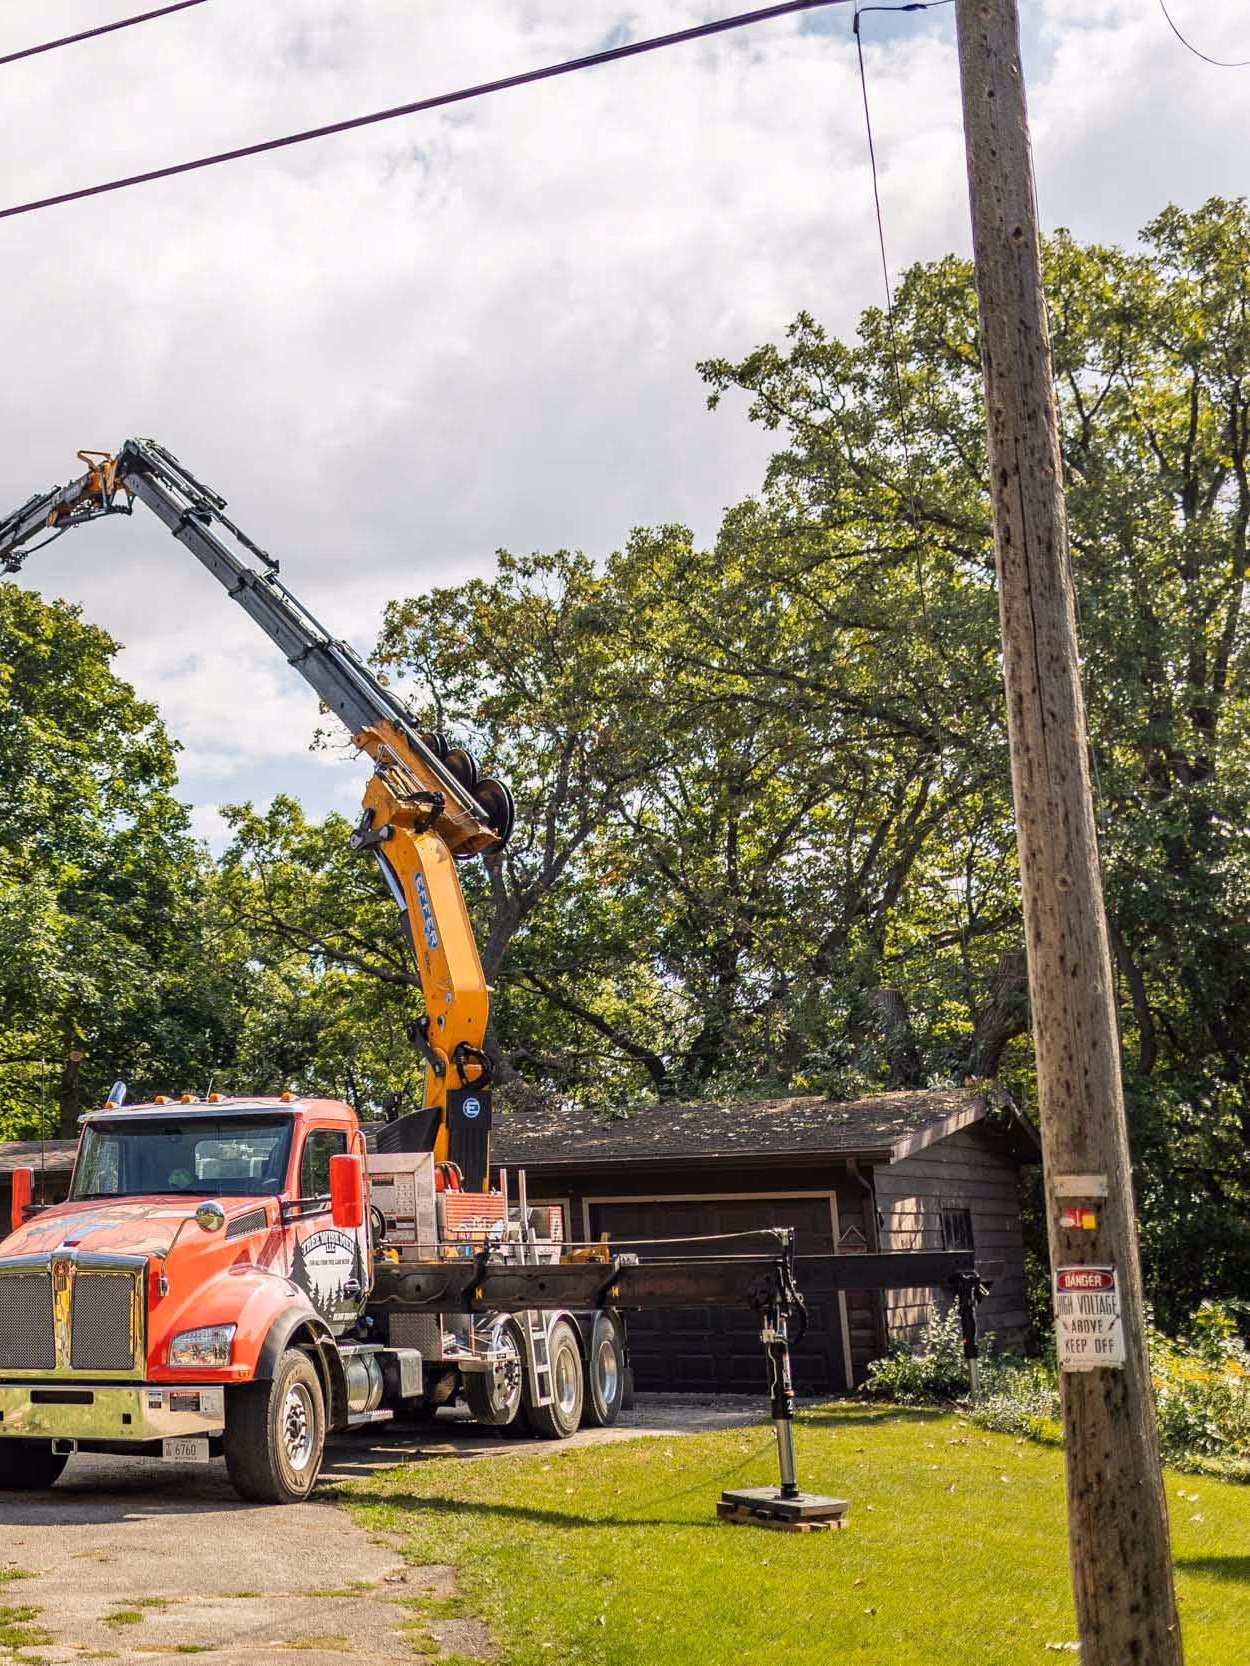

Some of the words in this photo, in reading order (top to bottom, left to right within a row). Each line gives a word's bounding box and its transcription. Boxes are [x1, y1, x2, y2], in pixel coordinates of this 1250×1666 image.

[320, 1231, 340, 1244] WISE
[1065, 1275, 1102, 1287] DANGER
[1056, 1295, 1073, 1314] HIGH
[1077, 1295, 1117, 1315] VOLTAGE
[1071, 1319, 1103, 1334] ABOVE
[1065, 1339, 1087, 1354] KEEP
[1094, 1339, 1115, 1354] OFF
[175, 1443, 197, 1456] 6760
